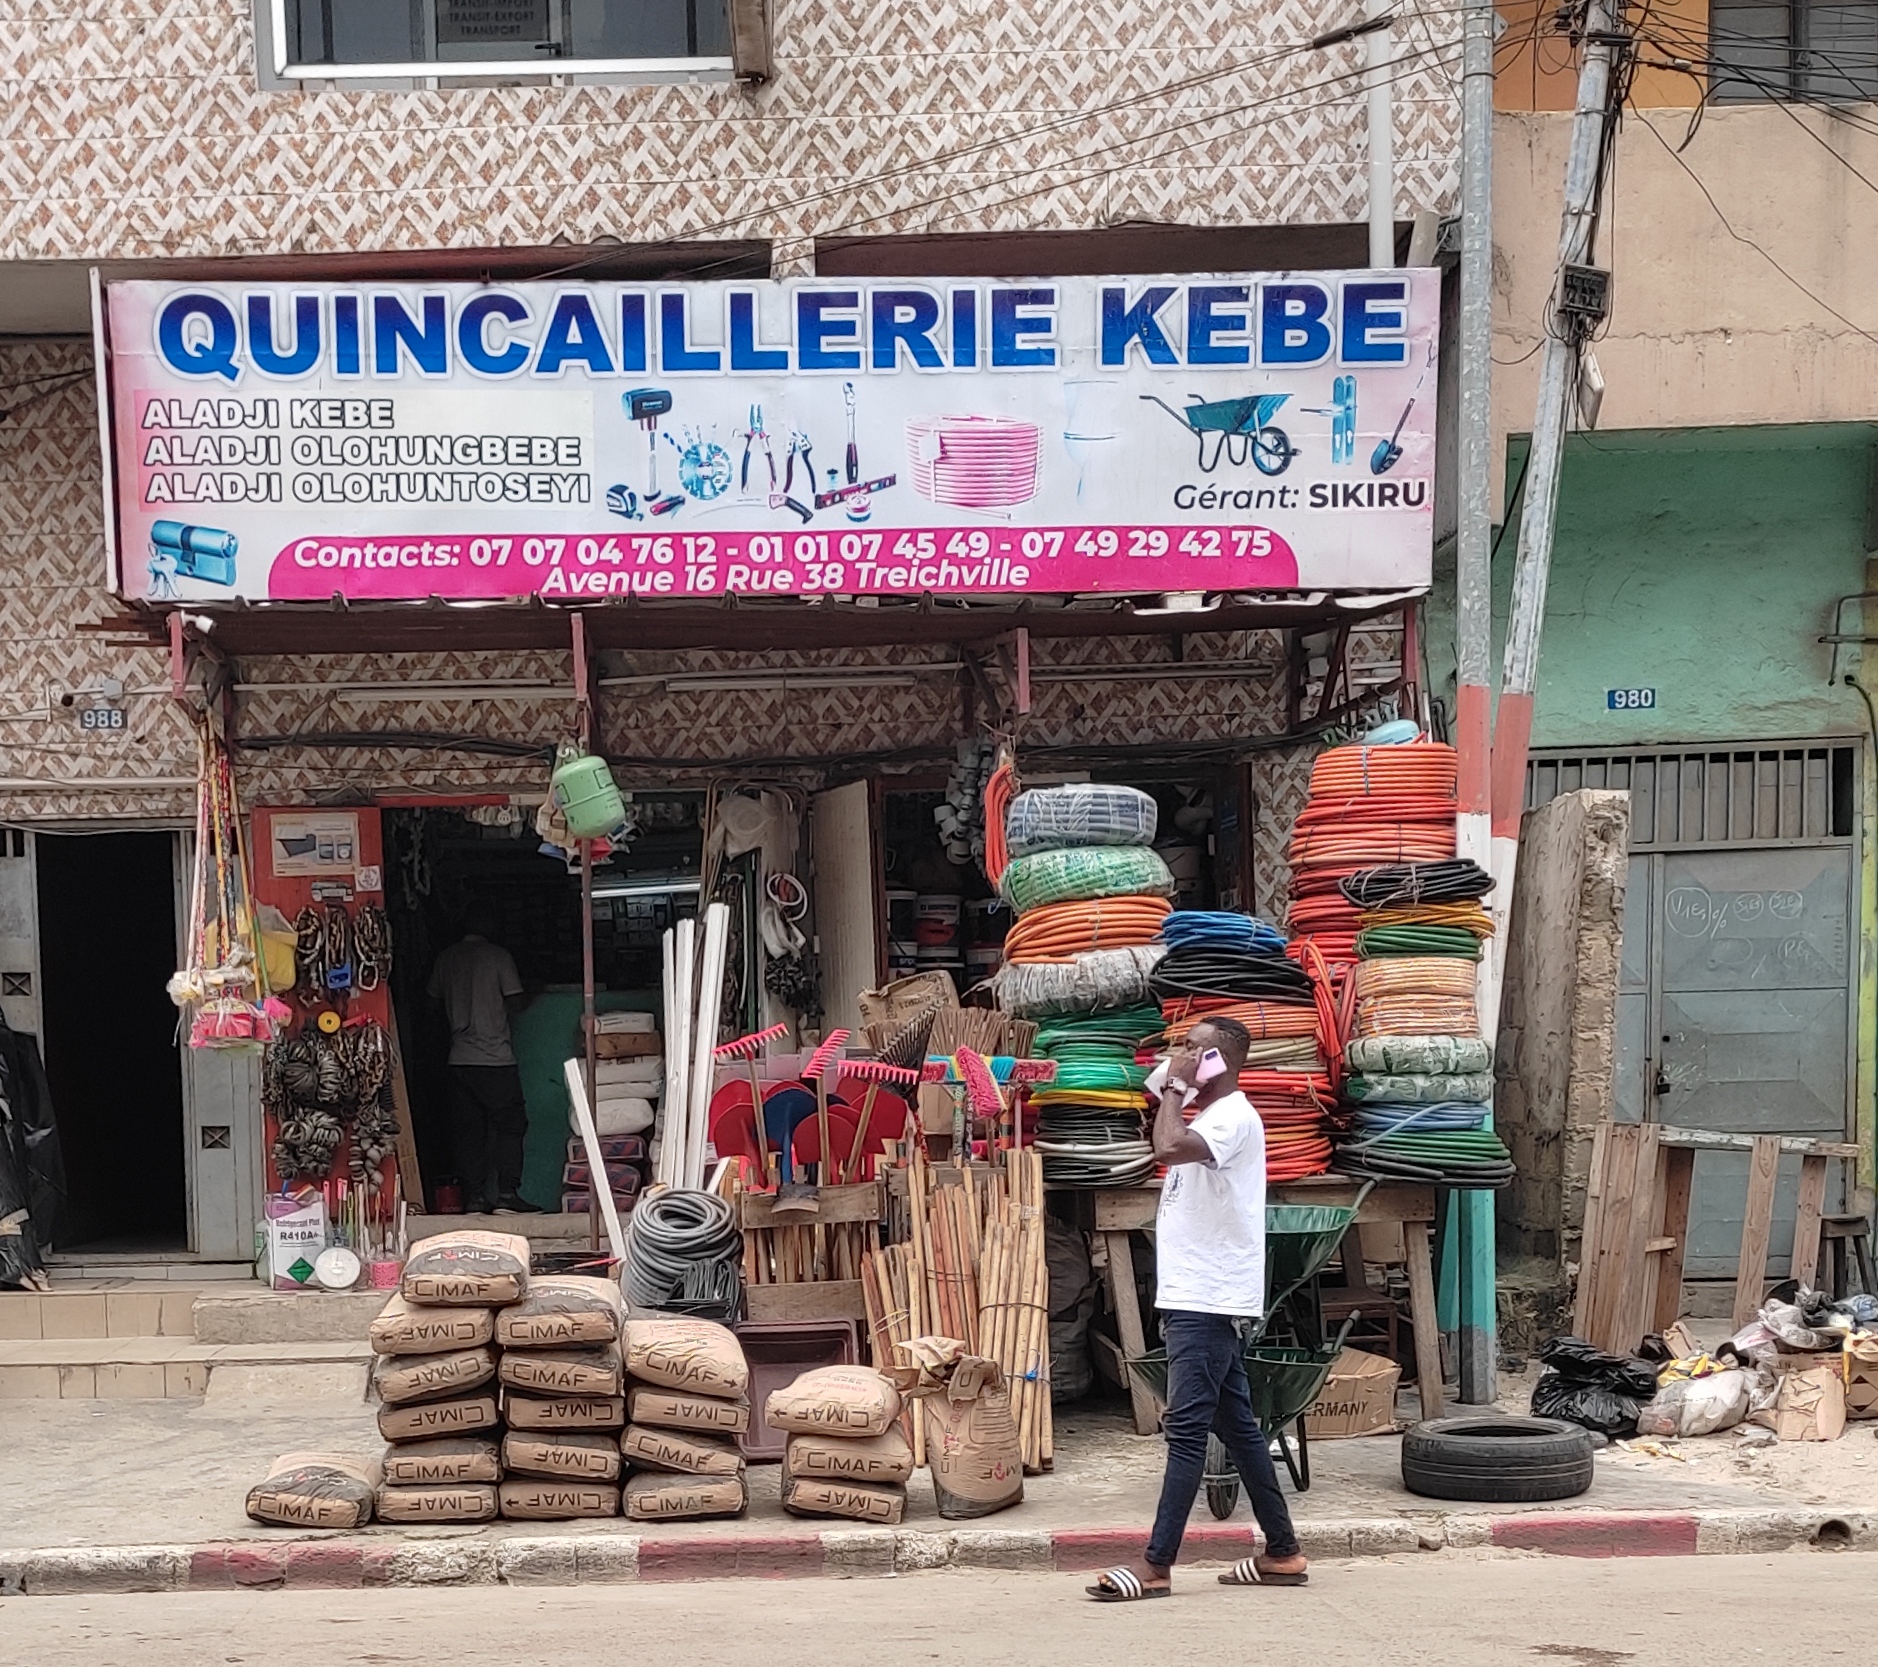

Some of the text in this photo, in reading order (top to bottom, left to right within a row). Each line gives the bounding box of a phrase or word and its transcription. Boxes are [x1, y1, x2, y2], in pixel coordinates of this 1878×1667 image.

[461, 25, 520, 35] TRANSPORT
[157, 281, 1406, 383] QUINCAILLERIE KEBE
[141, 398, 395, 429] ALADJI KEBE
[143, 435, 582, 466] ALADJI OLOHUNGBEBE
[145, 472, 591, 503] ALADJI OLOHUNTOSEYI
[1173, 481, 1426, 510] Gérant: SIKIRU
[294, 540, 461, 568] Contacts:
[469, 538, 514, 566] 07
[522, 538, 567, 565] 07
[577, 538, 623, 565] 04
[631, 537, 674, 565] 76
[682, 536, 717, 564] 12
[748, 535, 784, 563] 01
[794, 535, 829, 563] 01
[839, 533, 882, 561] 07
[893, 532, 936, 560] 45
[946, 531, 991, 558] 49
[1021, 530, 1065, 558] 07
[1074, 530, 1119, 557] 49
[1128, 530, 1169, 557] 29
[1178, 530, 1222, 557] 42
[1231, 530, 1272, 557] 75
[541, 557, 1030, 593] Avenue 16 Rue 38 Treichville
[1614, 688, 1653, 708] 980
[83, 710, 123, 729] 988
[427, 1249, 500, 1262] CIMAF
[415, 1280, 491, 1297] CIMAF
[401, 1322, 476, 1341] CIMAF
[510, 1322, 584, 1339] CIMAF
[409, 1356, 481, 1388] CIMAF
[513, 1363, 588, 1386] CIMAF
[646, 1352, 718, 1382] CIMAF
[409, 1406, 484, 1428] CIMAF
[539, 1403, 613, 1421] CIMAF
[663, 1403, 739, 1426] CIMAF
[795, 1405, 869, 1428] CIMAF
[1303, 1400, 1369, 1417] ERMANY
[534, 1450, 608, 1472] CIMAF
[637, 1436, 716, 1469] CIMAF
[807, 1452, 883, 1473] CIMAF
[396, 1462, 471, 1479] CIMAF
[258, 1495, 332, 1521] CIMAF
[407, 1495, 483, 1513] CIMAF
[527, 1493, 601, 1510] CIMAF
[639, 1495, 714, 1512] CIMAF
[817, 1491, 891, 1517] CIMAF
